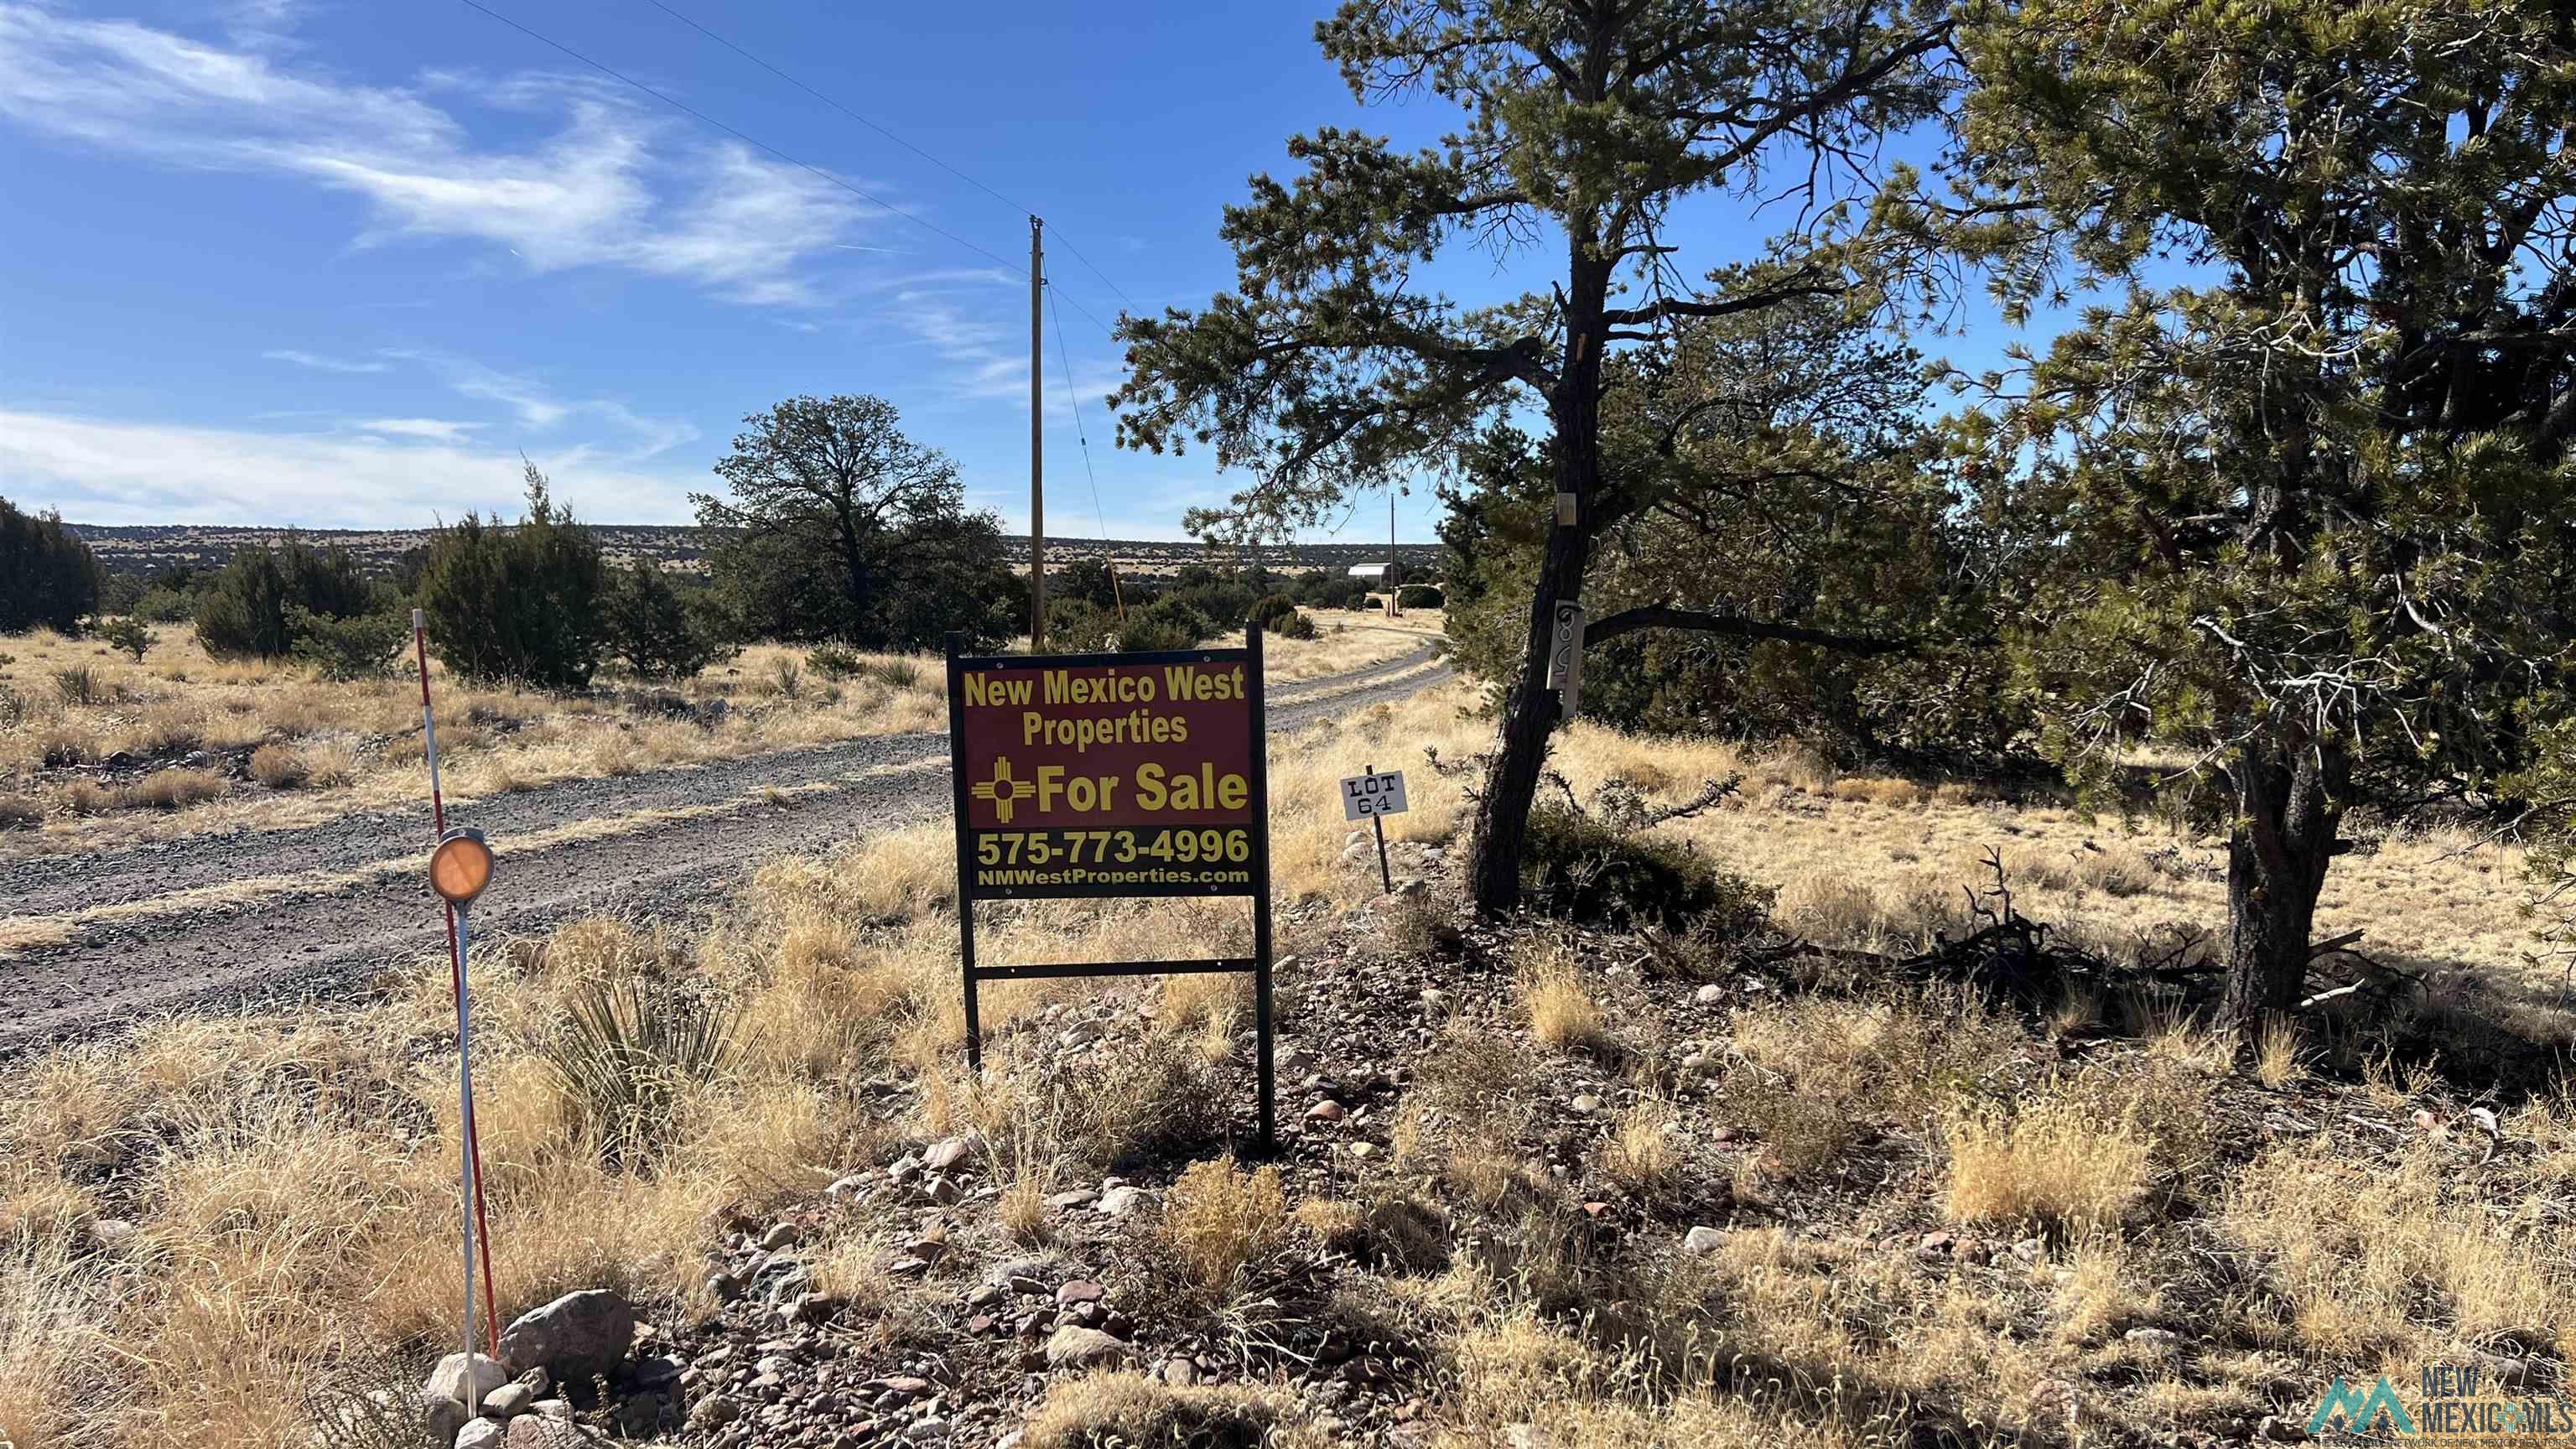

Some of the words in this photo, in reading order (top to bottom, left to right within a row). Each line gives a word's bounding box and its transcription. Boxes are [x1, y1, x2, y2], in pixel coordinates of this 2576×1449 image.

[963, 673, 1033, 707] New
[1042, 668, 1156, 705] Mexico
[1164, 664, 1245, 701] West
[1023, 709, 1187, 753] Properties
[1036, 765, 1119, 813] For
[1135, 762, 1249, 811] Sale
[1348, 775, 1395, 797] LOT
[1358, 795, 1392, 814] 64
[978, 829, 1249, 865] 575-773-4996
[978, 869, 1249, 886] NMWestProperties.com
